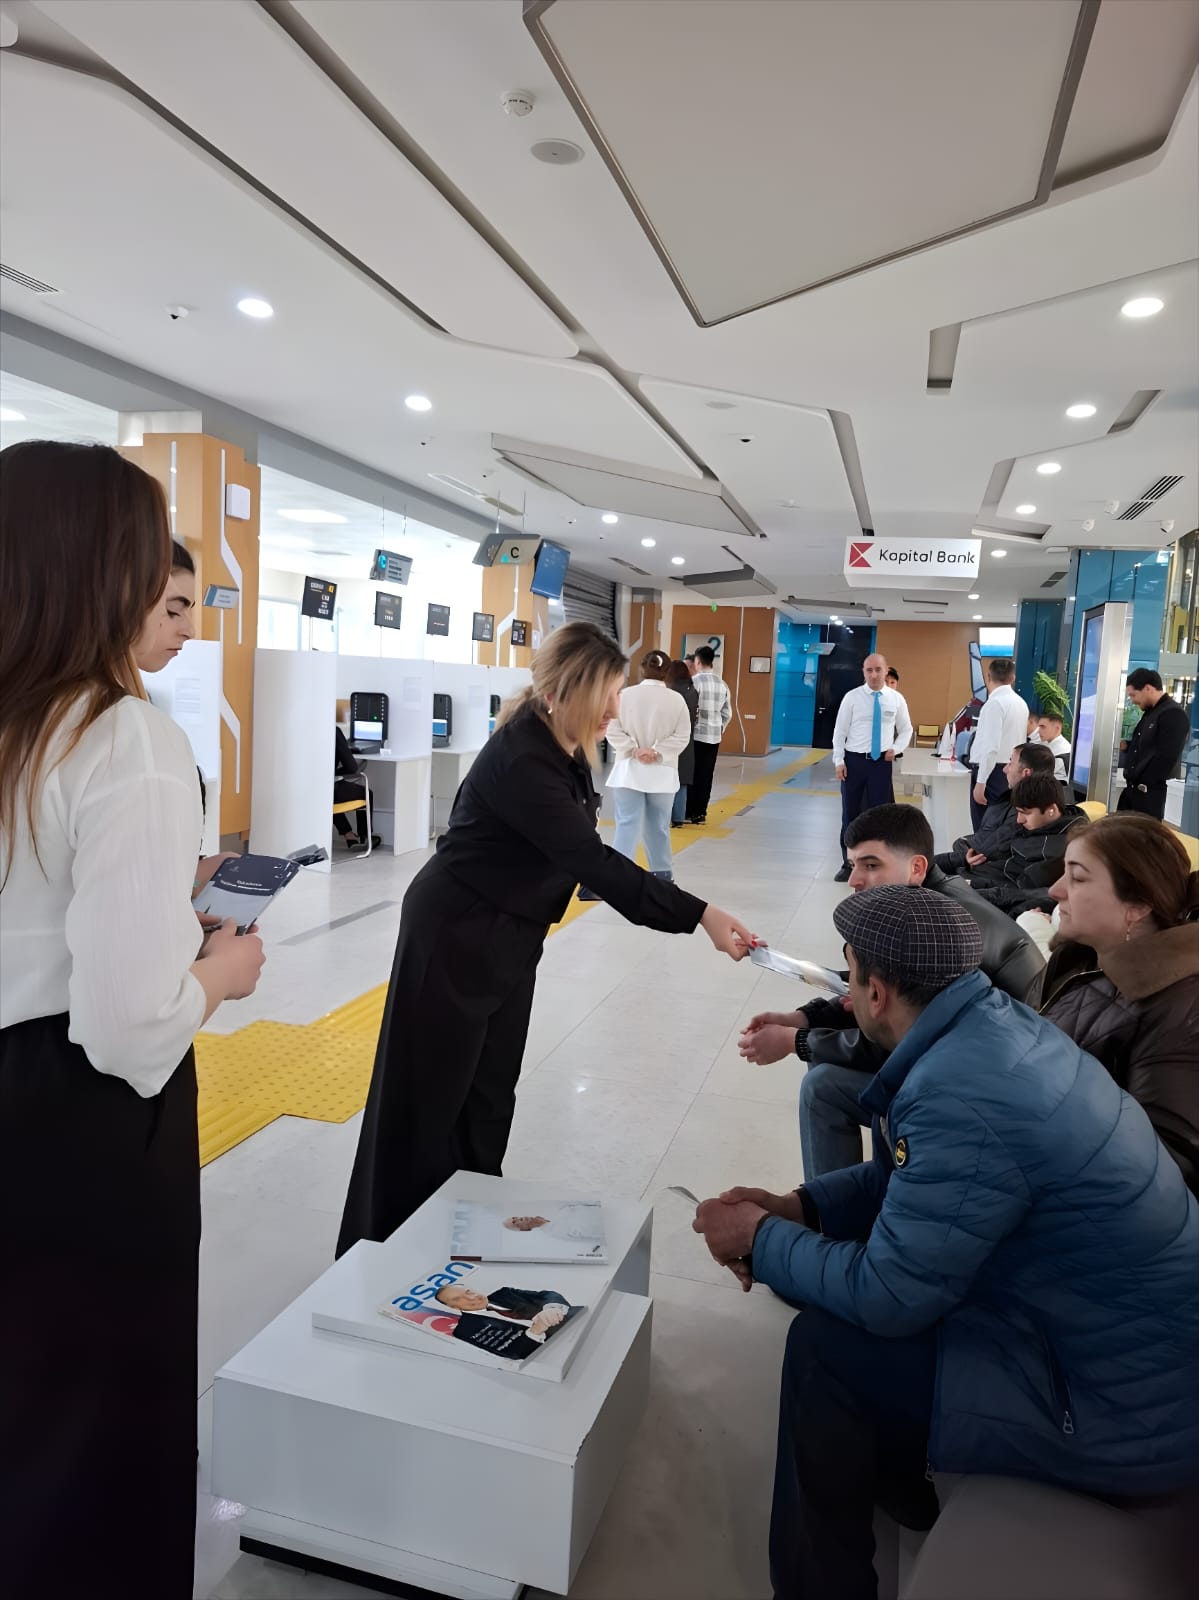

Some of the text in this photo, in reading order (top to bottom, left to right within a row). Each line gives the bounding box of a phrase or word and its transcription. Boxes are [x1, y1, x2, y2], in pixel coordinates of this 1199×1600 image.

[510, 546, 520, 559] C
[879, 549, 976, 564] Kapital Bank
[391, 1261, 475, 1311] asan
